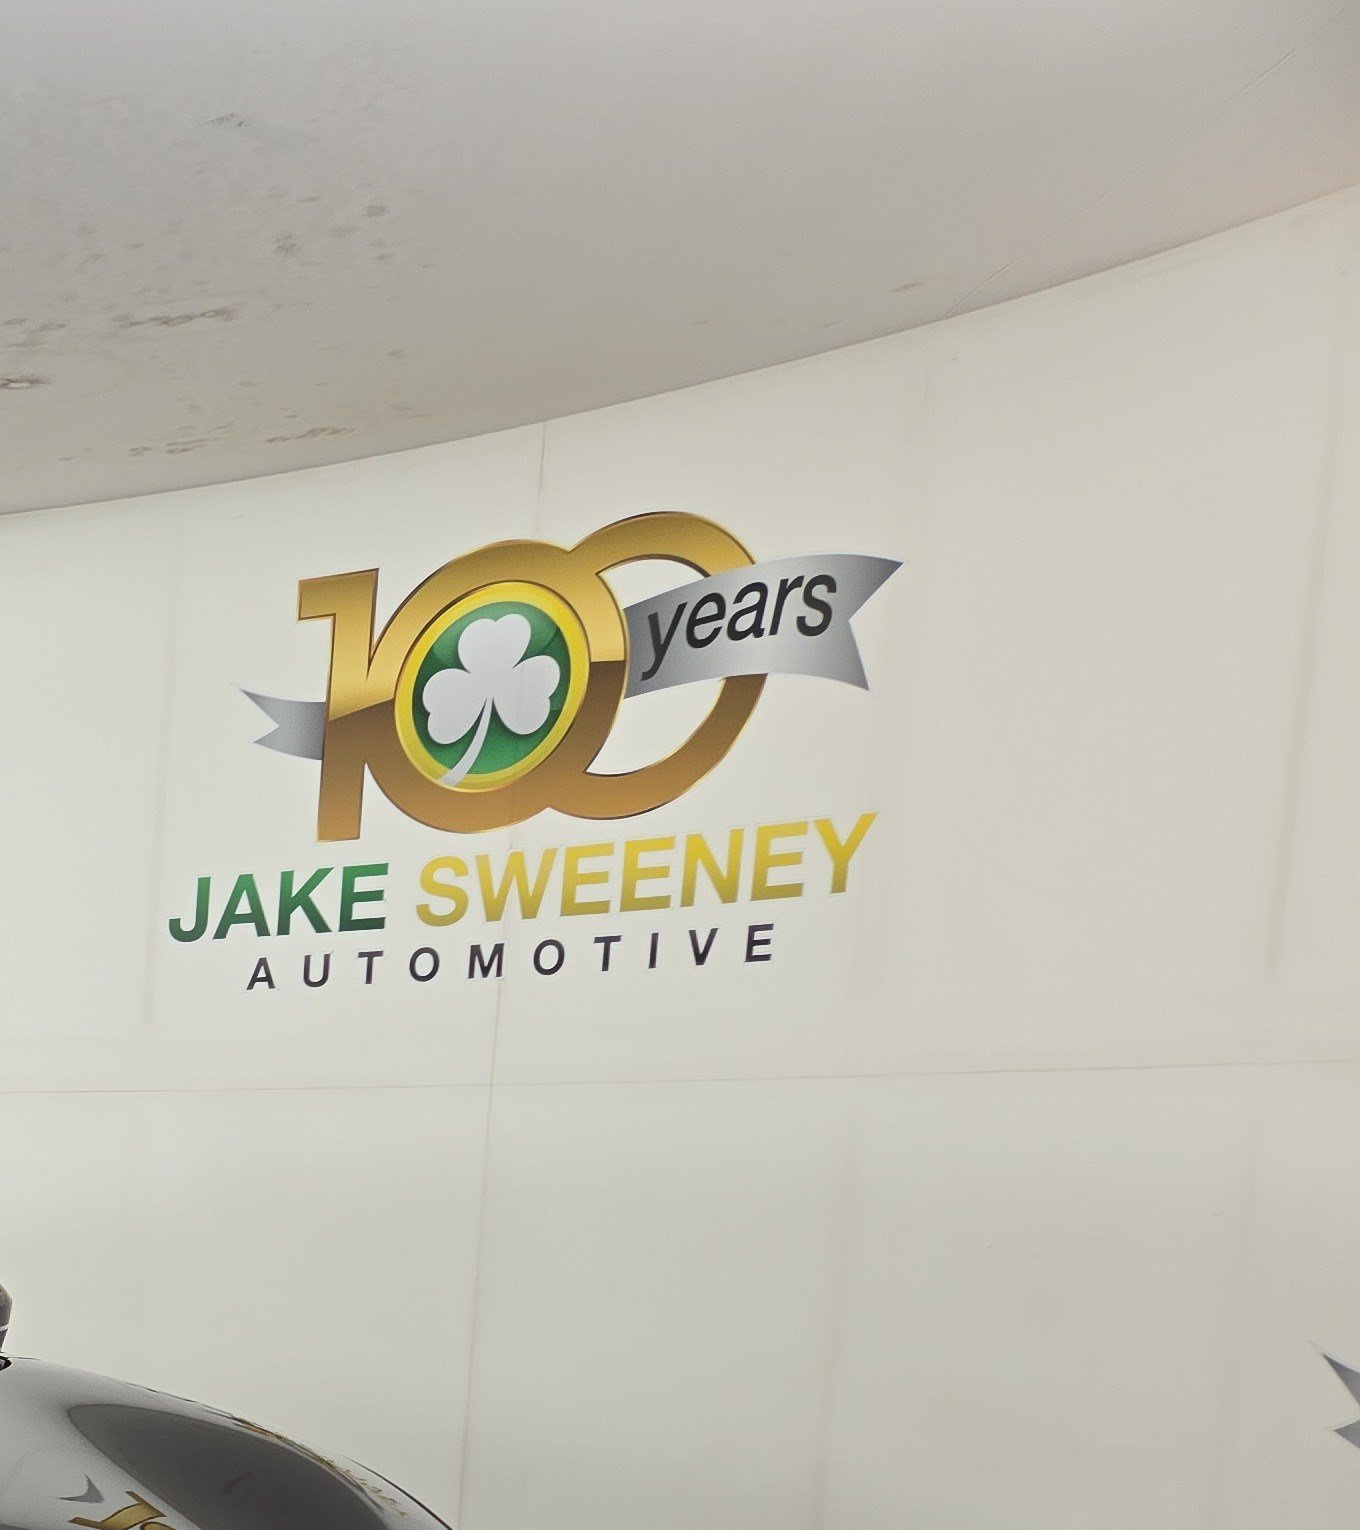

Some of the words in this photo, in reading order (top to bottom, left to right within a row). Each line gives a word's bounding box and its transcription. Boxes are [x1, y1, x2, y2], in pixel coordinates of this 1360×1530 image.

[297, 510, 770, 843] 100
[640, 571, 837, 681] years
[168, 861, 389, 942] JAKE
[416, 812, 879, 927] SWEENEY
[246, 923, 775, 991] AUTOMOTIVE
